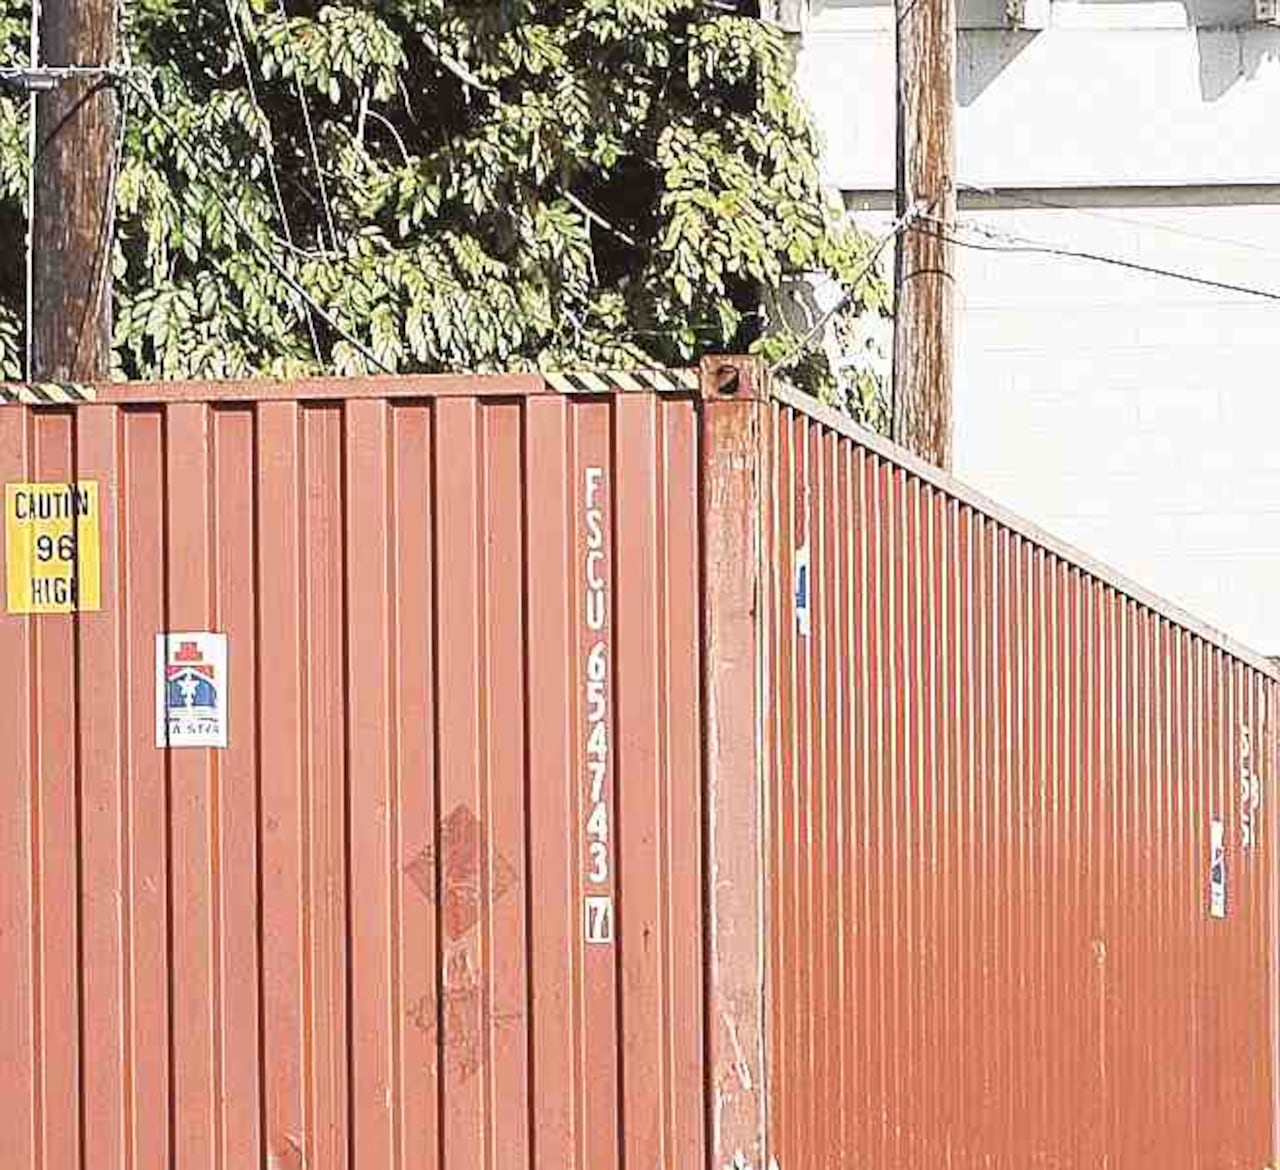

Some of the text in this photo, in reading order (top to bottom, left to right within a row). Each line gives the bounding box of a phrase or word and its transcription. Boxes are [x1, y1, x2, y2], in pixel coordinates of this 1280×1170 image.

[15, 490, 88, 519] CAUTIN
[585, 467, 604, 630] FSCU
[587, 641, 608, 883] 654743
